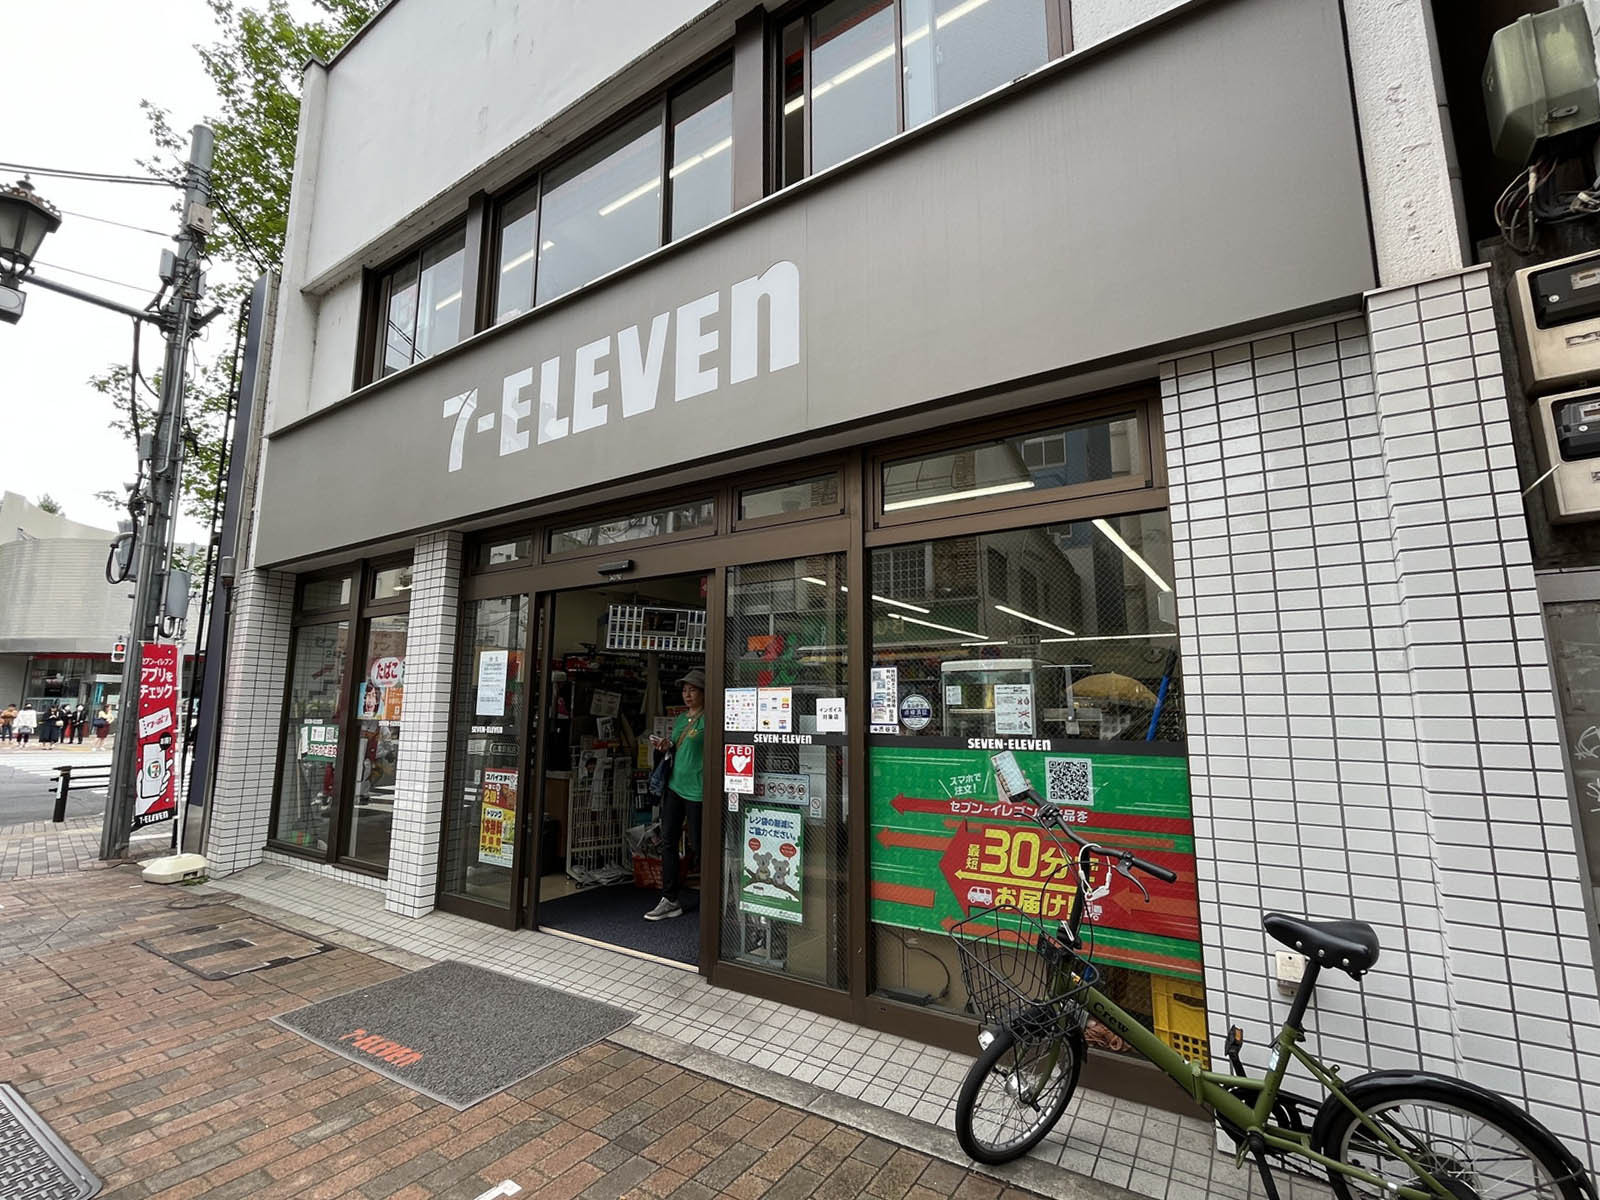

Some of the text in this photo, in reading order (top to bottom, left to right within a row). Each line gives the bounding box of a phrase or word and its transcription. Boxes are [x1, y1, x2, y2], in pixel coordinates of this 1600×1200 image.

[141, 667, 173, 683] アプリを
[376, 661, 398, 679] たばこ
[140, 684, 173, 699] チェック
[728, 746, 752, 755] AED
[950, 773, 982, 786] スマホで
[966, 844, 981, 870] 最短
